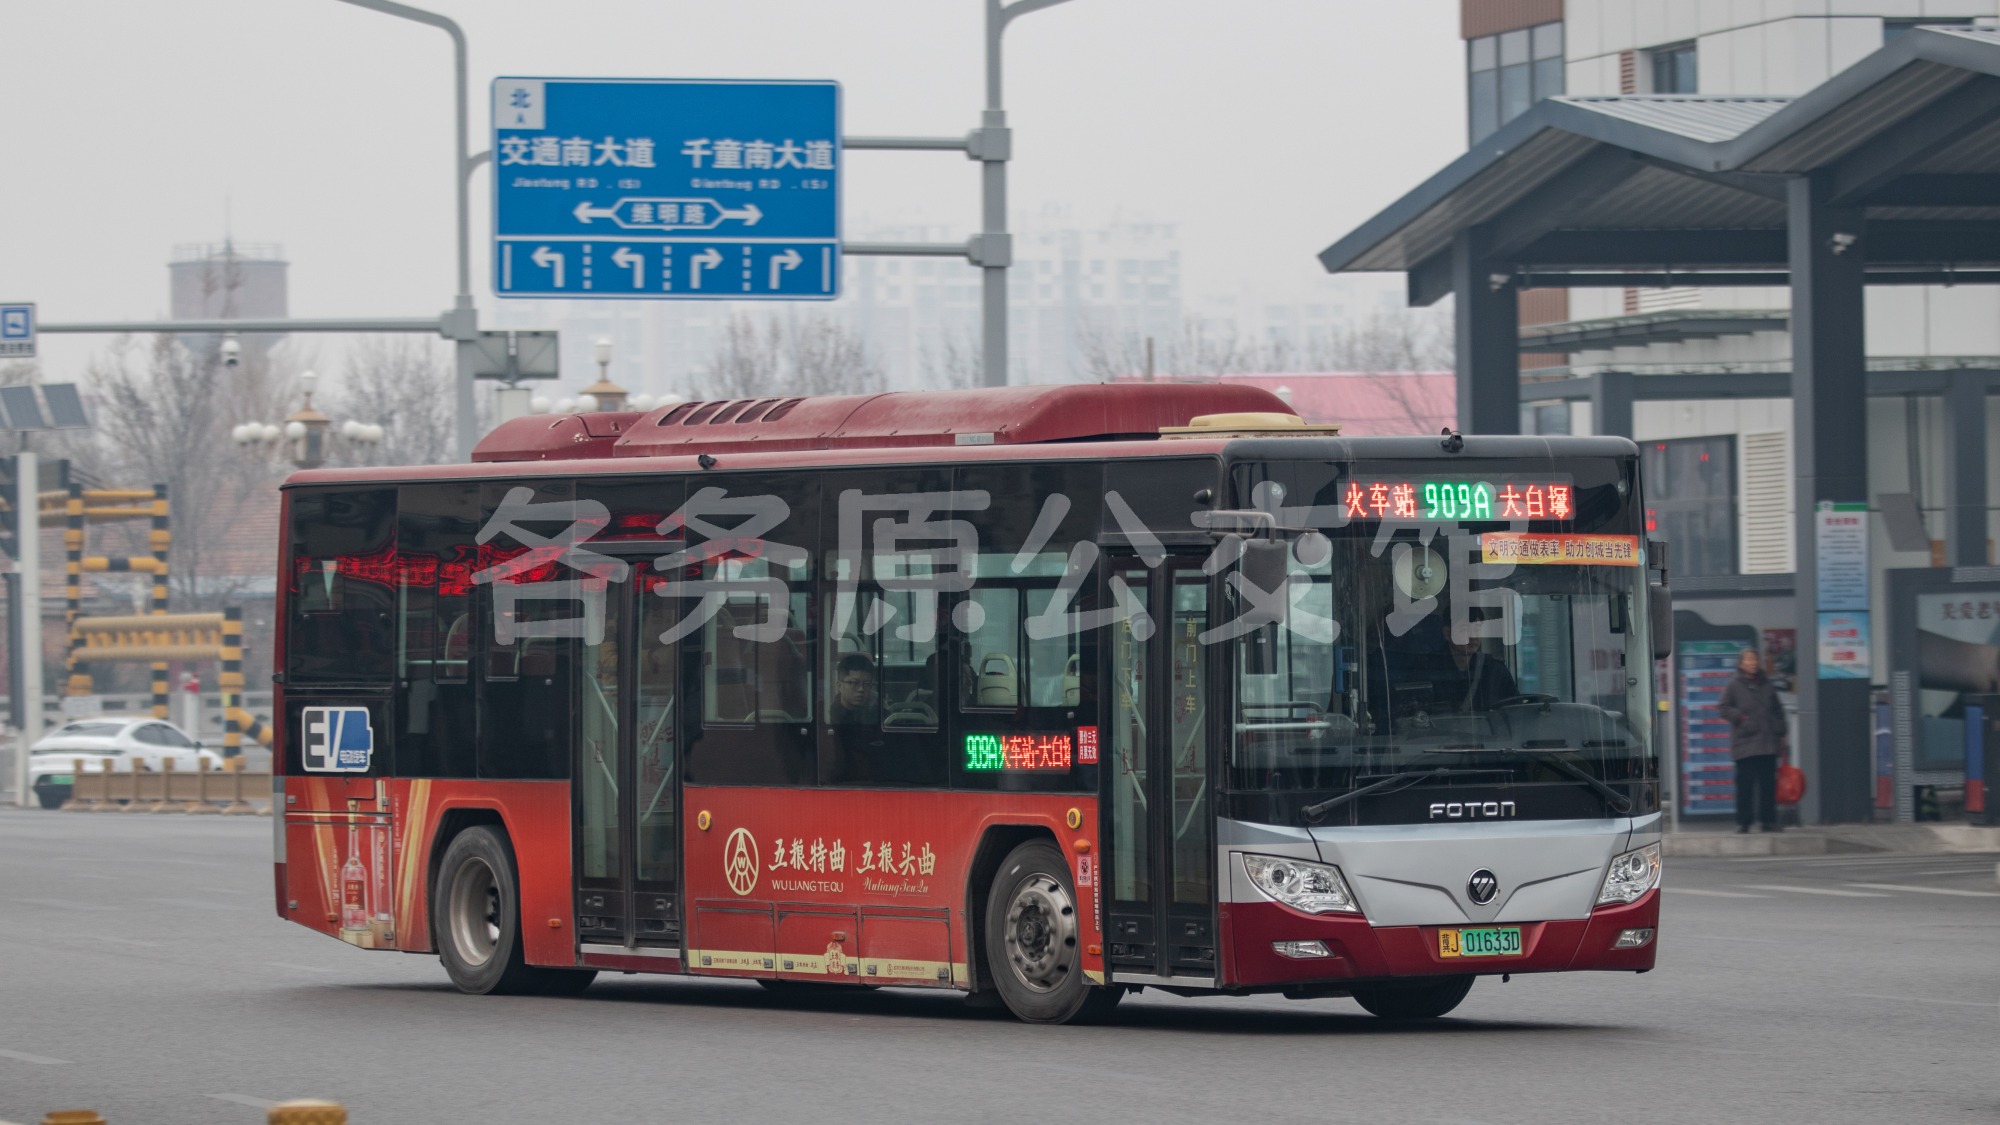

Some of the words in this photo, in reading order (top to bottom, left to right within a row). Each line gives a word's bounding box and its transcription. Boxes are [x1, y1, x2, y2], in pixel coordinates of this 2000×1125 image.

[500, 137, 656, 167] 交通南大道
[681, 139, 834, 170] 千童南大道
[1346, 483, 1415, 519] 火车站
[1424, 483, 1491, 519] 909A
[1488, 538, 1560, 557] 文明交通做表率
[1565, 540, 1632, 559] 助力创城当先锋
[1185, 617, 1197, 714] 前门上车
[1429, 801, 1516, 819] FOTON
[768, 837, 846, 873] 五粮特曲
[855, 840, 936, 877] 五粮头曲
